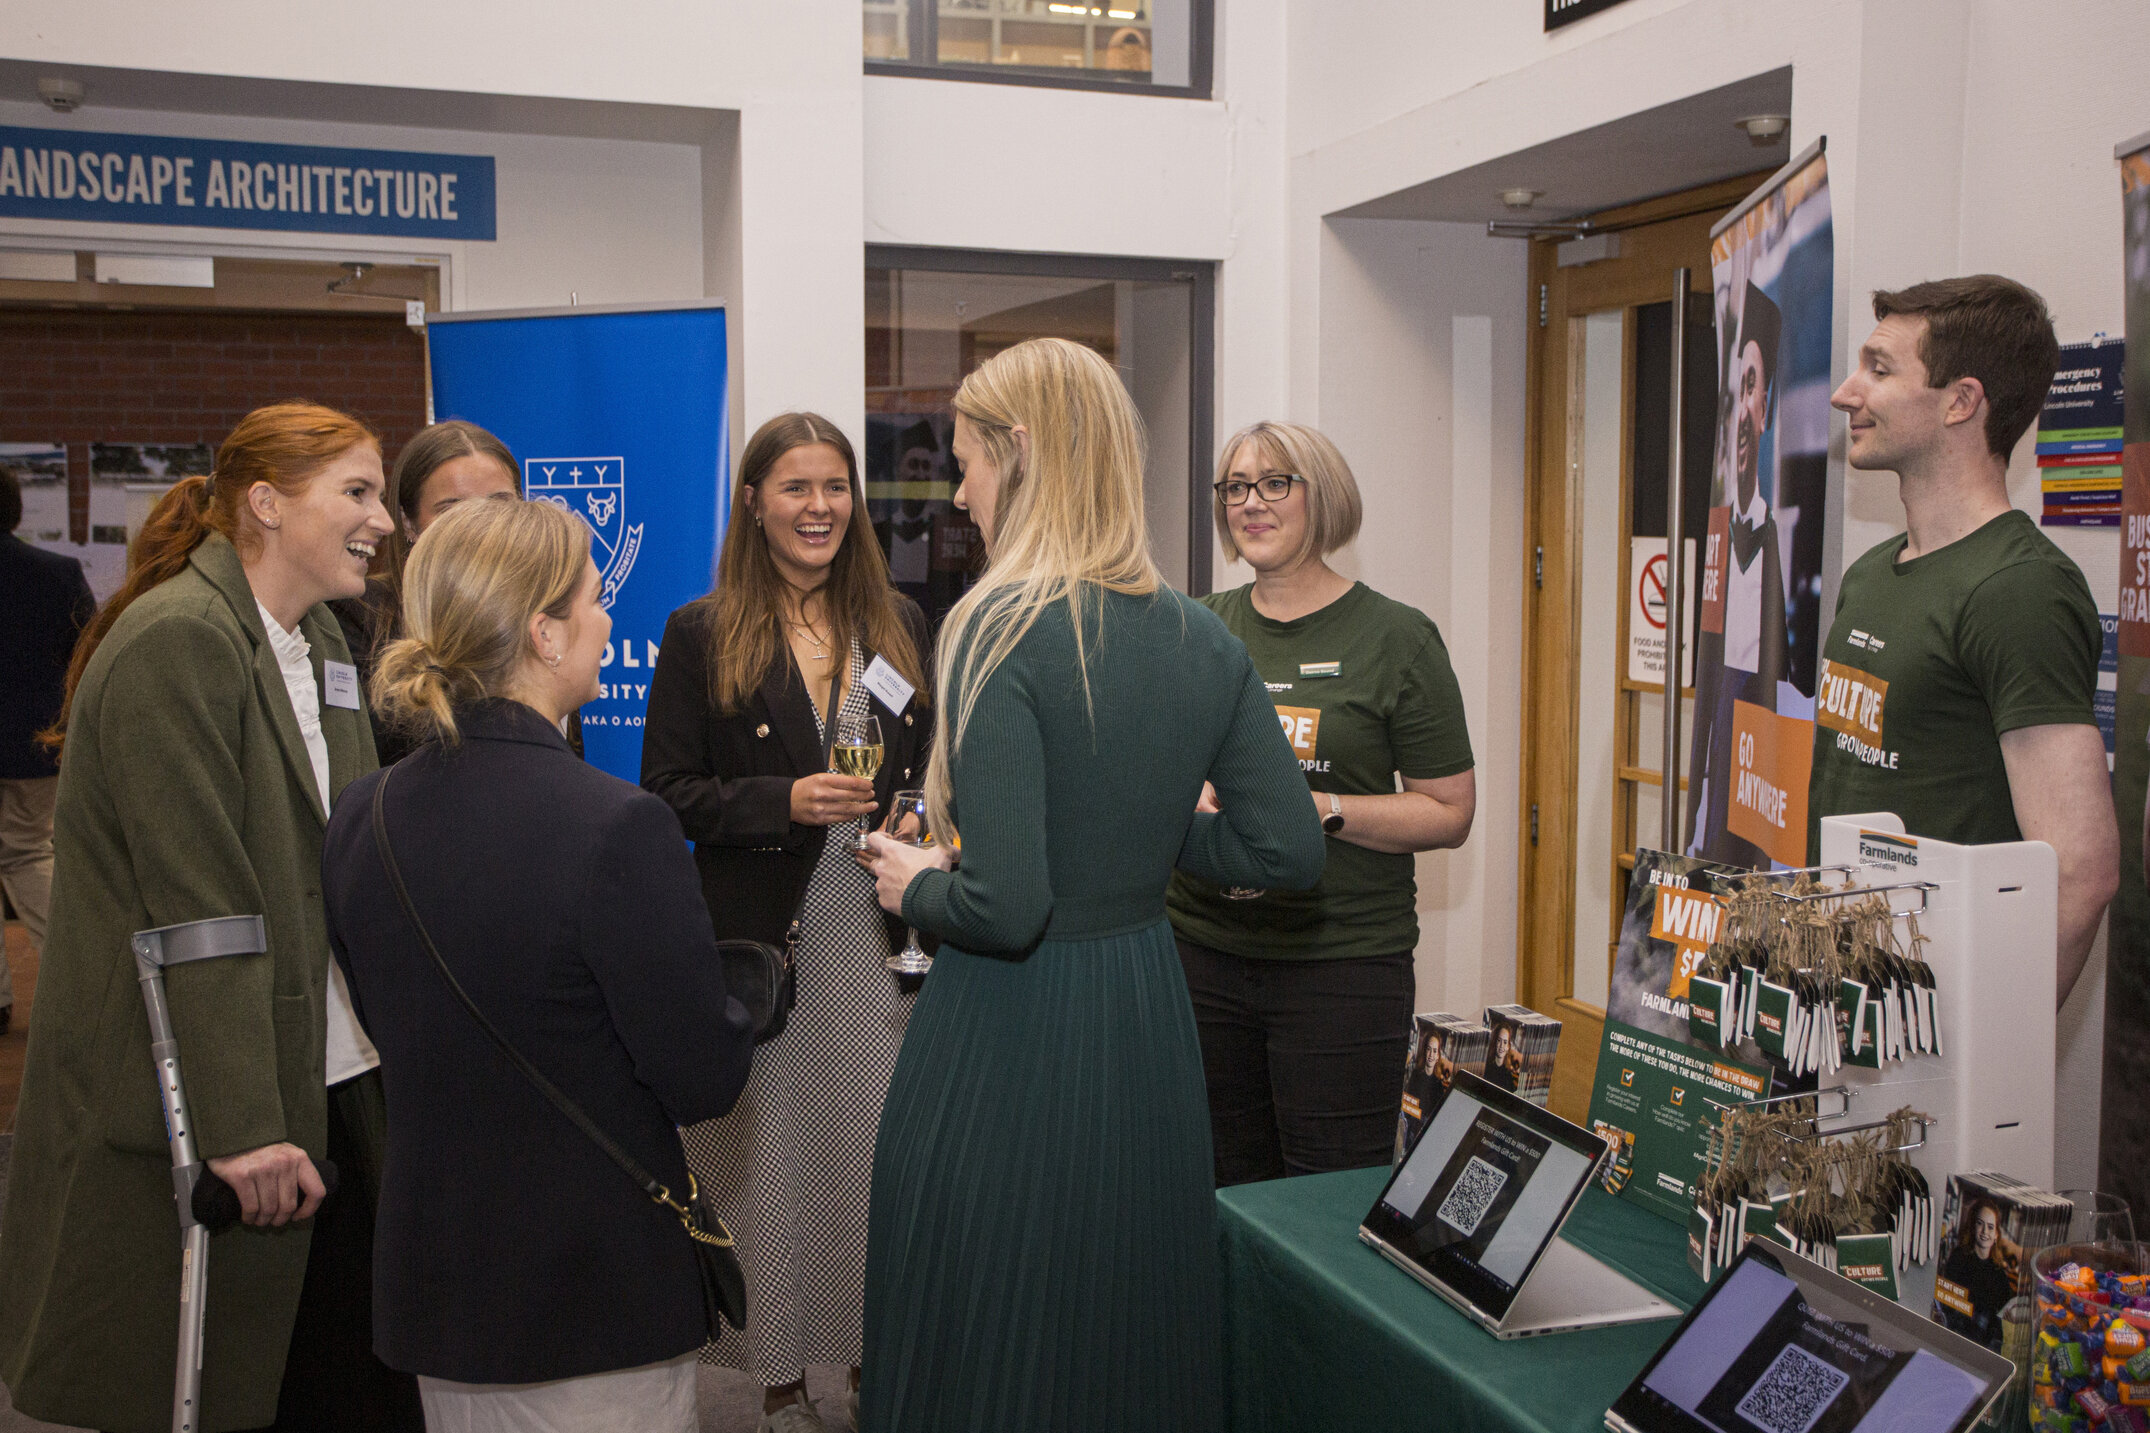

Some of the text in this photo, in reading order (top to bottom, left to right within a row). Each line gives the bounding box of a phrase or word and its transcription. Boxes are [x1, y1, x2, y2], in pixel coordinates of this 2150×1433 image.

[205, 160, 458, 221] ARCHITECTURE
[615, 537, 637, 582] PROBITATE
[1634, 637, 1652, 647] FOOD
[1643, 661, 1657, 671] THIS
[612, 716, 621, 726] O
[1738, 731, 1754, 769] GO
[1736, 770, 1788, 829] ANYWHERE
[1860, 842, 1918, 866] Farmlands
[1650, 868, 1689, 891] BE IN TO
[1662, 893, 1721, 944] WIN
[1610, 1031, 1760, 1089] COMPLETE ANY OF THE TASKS BELOW TO BE IN THE DRAW
[1610, 1042, 1619, 1053] THE
[1619, 1046, 1634, 1058] MORE
[1633, 1051, 1641, 1060] OF
[1641, 1053, 1658, 1066] THESE
[1658, 1060, 1669, 1070] YOU
[1679, 1066, 1690, 1078] THE
[1690, 1071, 1705, 1083] MORE
[1705, 1076, 1732, 1093] CHANCES
[1733, 1085, 1741, 1095] TO
[1657, 1179, 1683, 1195] Farmlands
[1846, 1266, 1882, 1276] CULTURE
